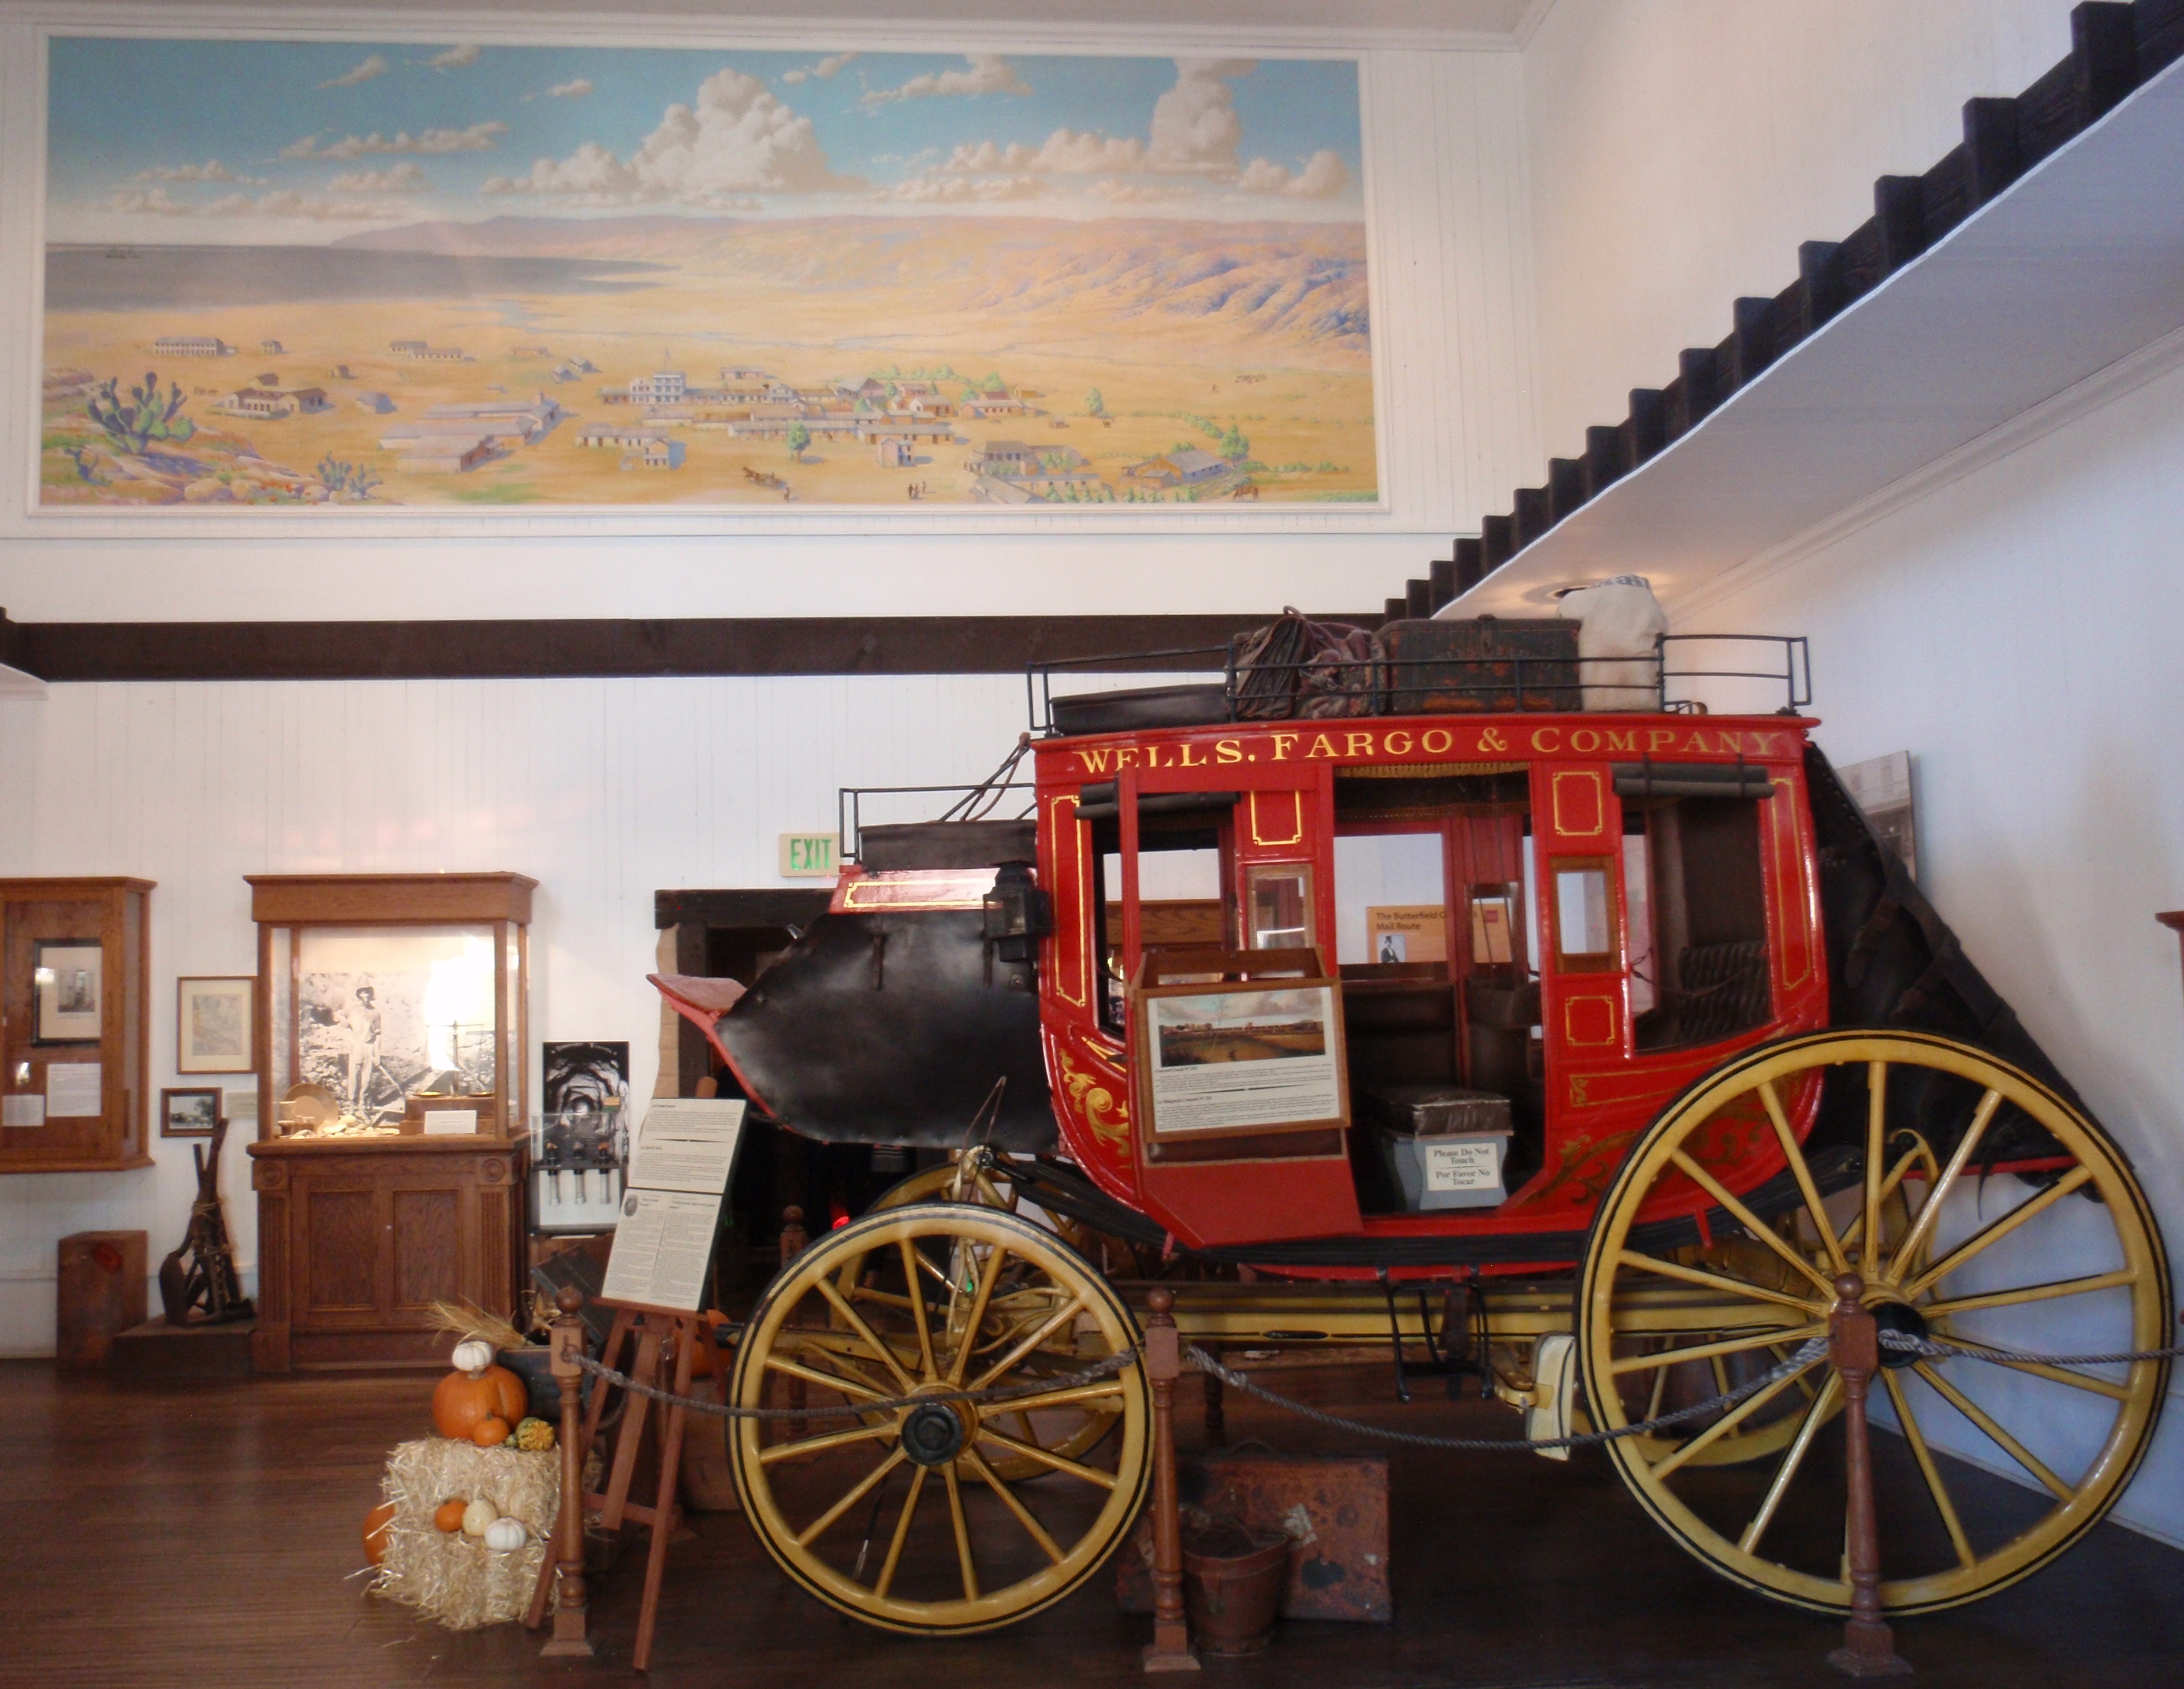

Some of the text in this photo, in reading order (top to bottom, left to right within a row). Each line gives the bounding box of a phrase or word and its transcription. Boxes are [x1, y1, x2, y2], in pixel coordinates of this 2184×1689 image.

[1270, 730, 1452, 760] FARGO
[1477, 727, 1507, 752] &
[1531, 728, 1783, 754] COMPANY
[790, 839, 831, 869] EXIT
[1393, 911, 1437, 920] Butterfield
